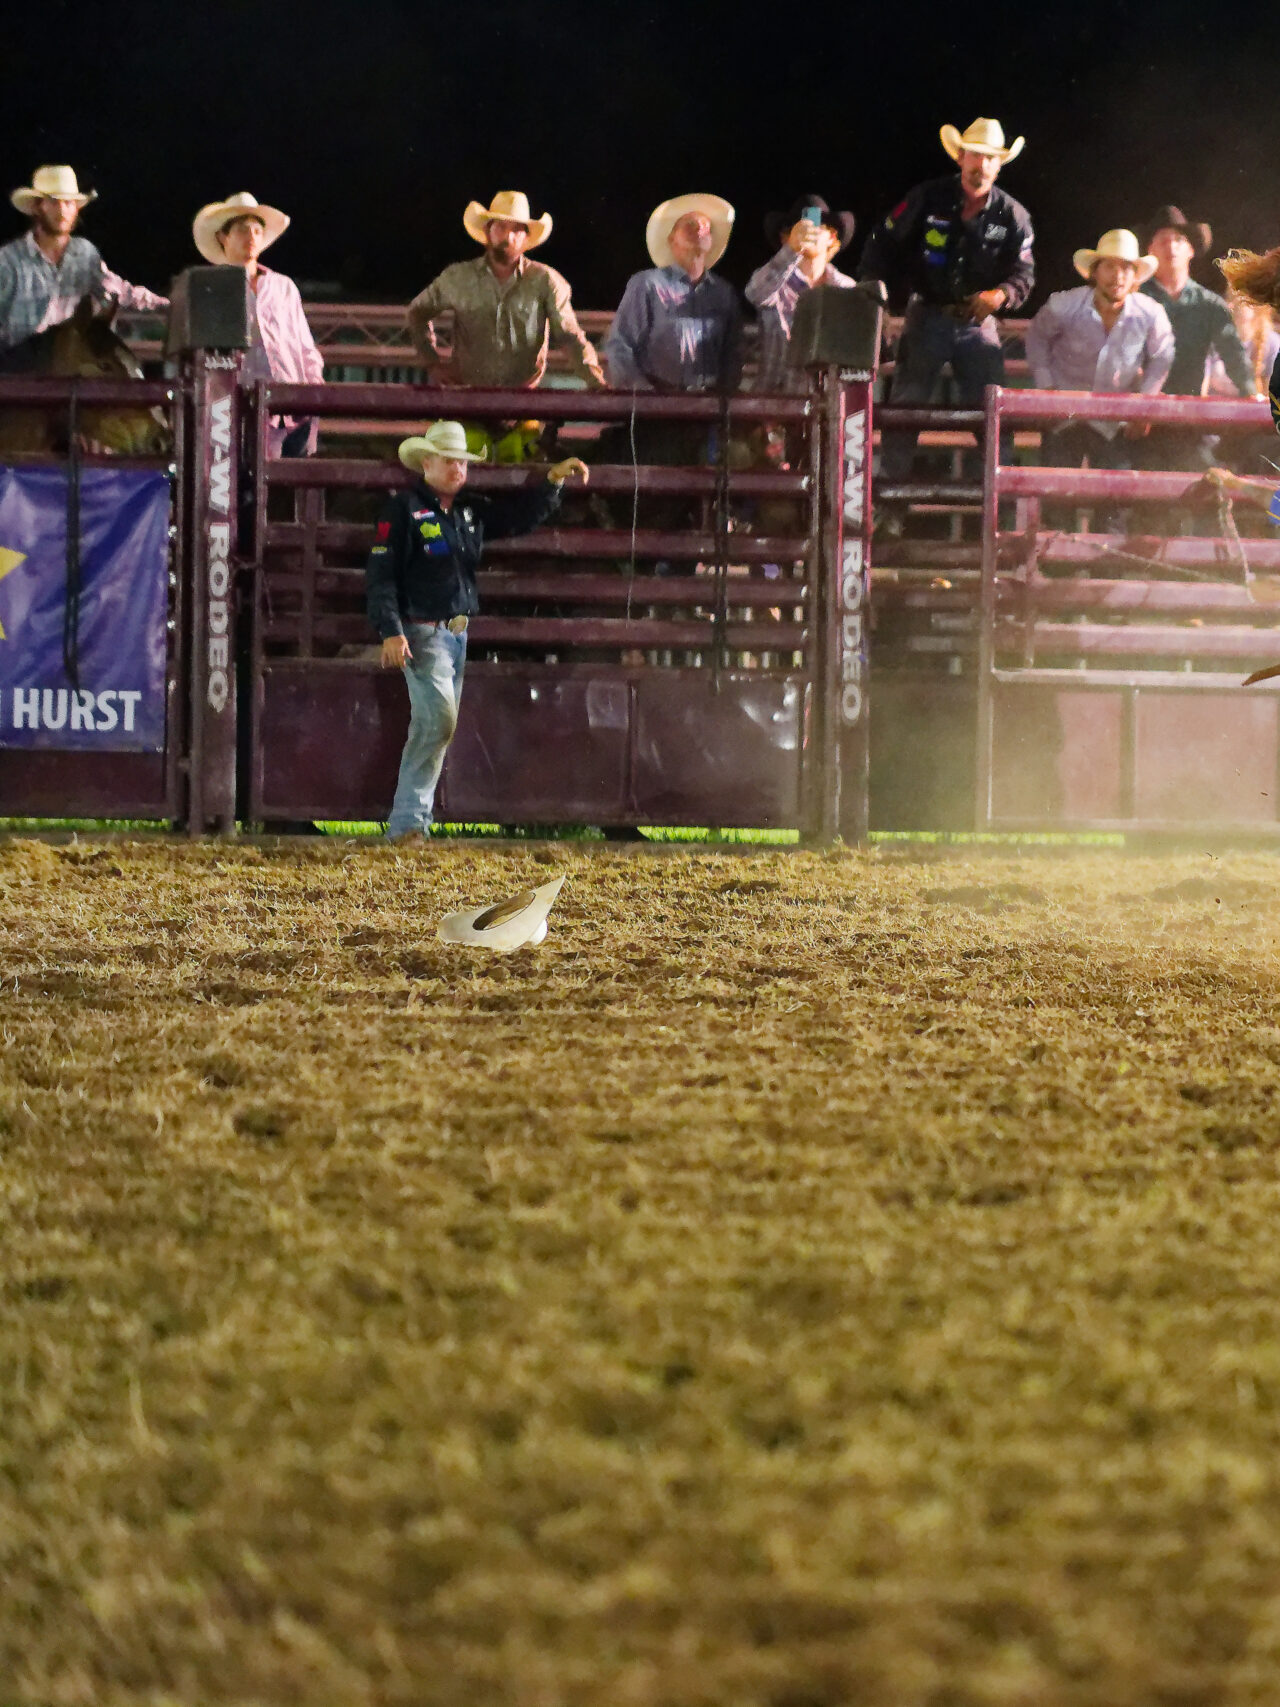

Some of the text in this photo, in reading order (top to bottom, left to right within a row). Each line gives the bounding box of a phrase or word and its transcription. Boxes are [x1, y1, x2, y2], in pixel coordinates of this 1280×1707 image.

[12, 687, 142, 732] HURST
[207, 394, 231, 712] W-W RODEO
[842, 409, 865, 722] W-W RODEO
